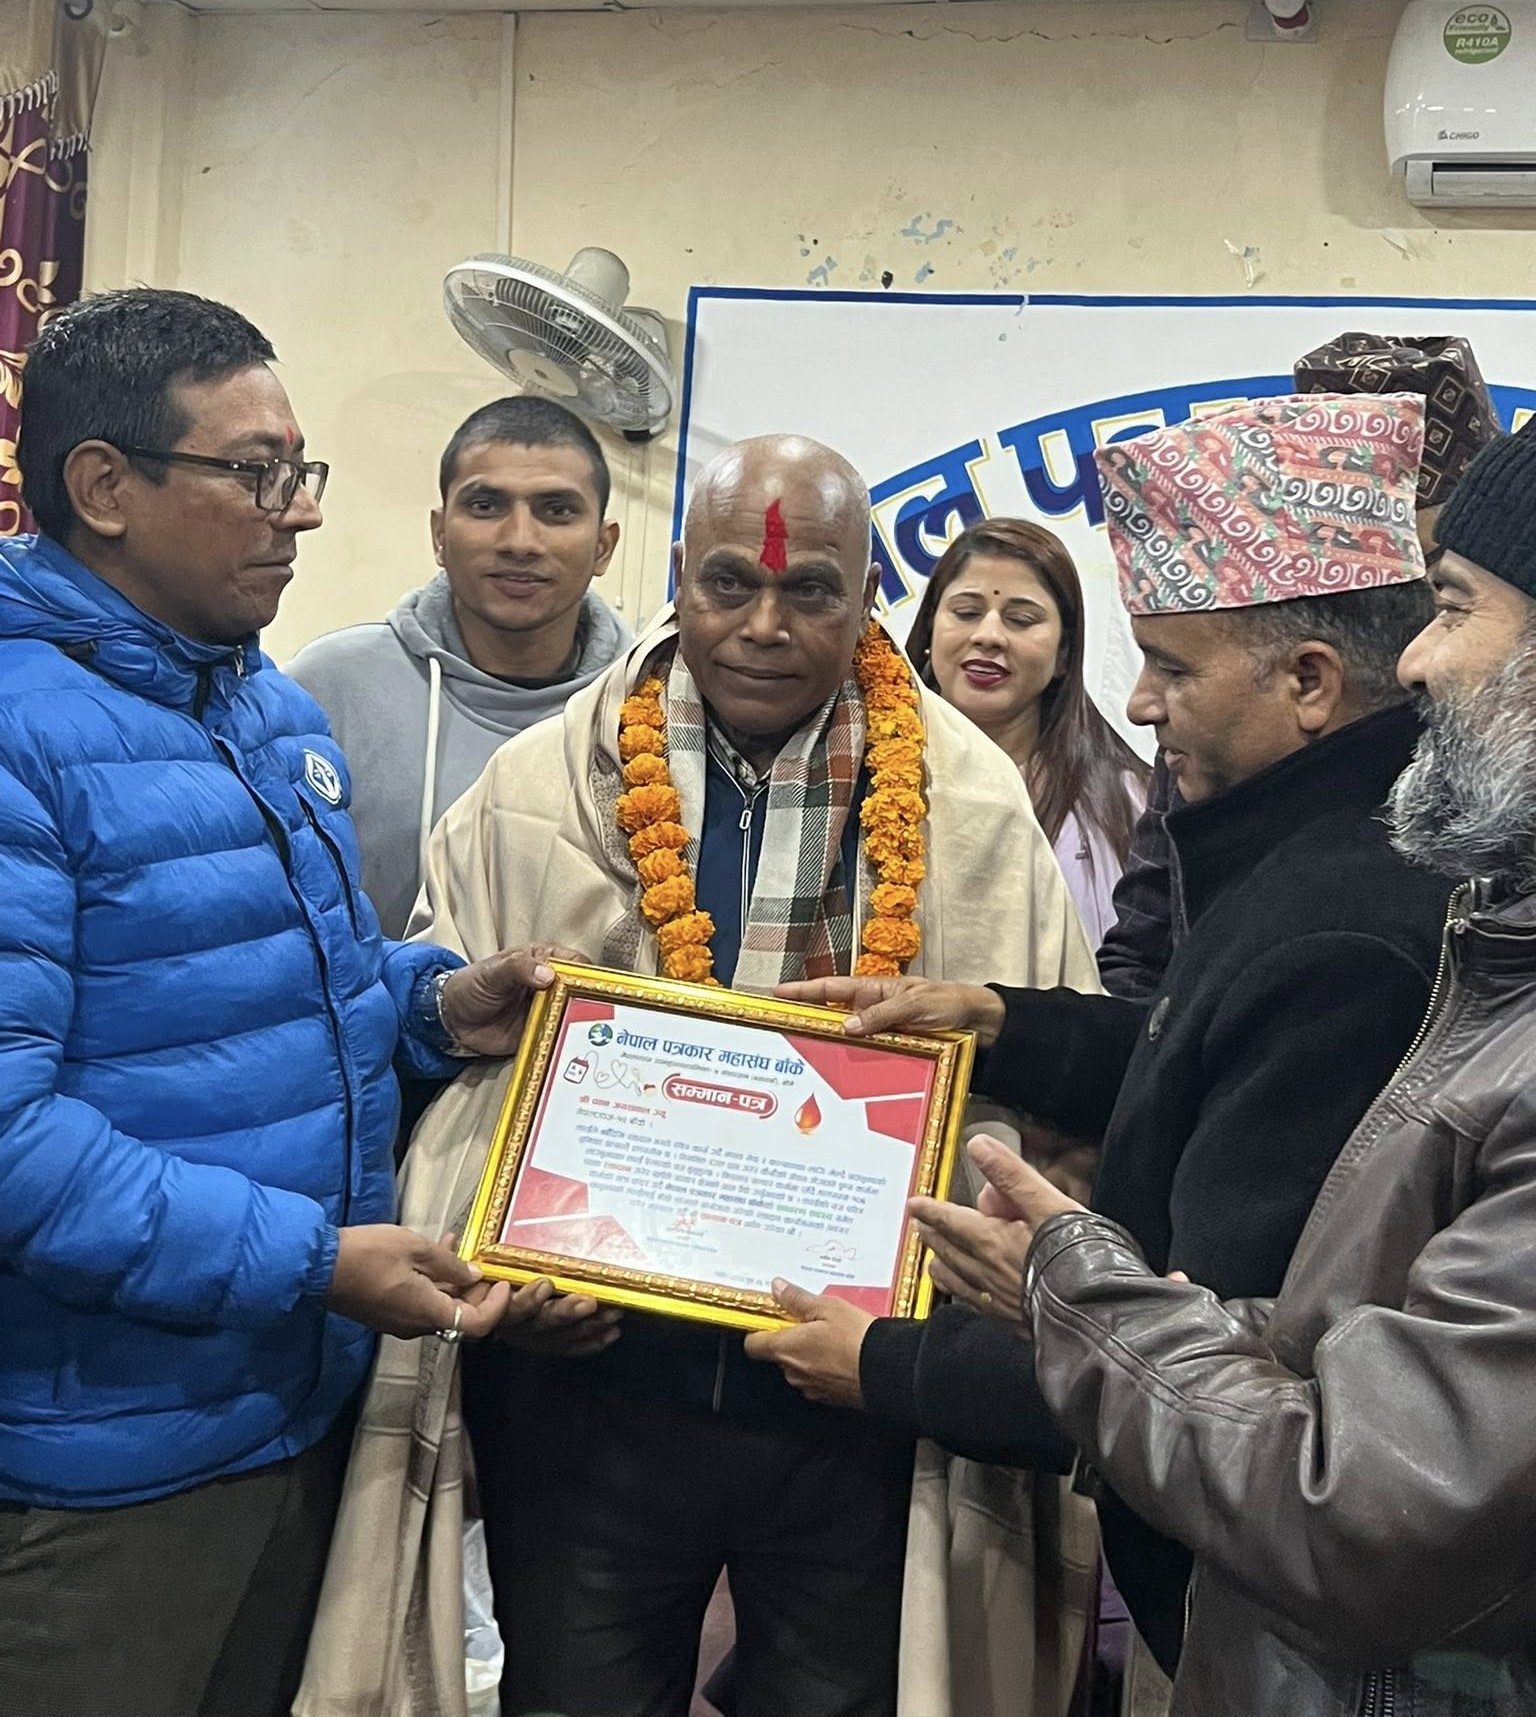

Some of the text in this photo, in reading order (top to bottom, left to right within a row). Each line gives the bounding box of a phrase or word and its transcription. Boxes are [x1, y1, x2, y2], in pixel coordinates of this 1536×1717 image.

[1455, 13, 1489, 24] eco
[1456, 37, 1499, 48] R410A
[1449, 131, 1480, 140] CHIGO
[616, 1028, 658, 1052] नेपाल
[662, 1040, 716, 1061] पत्रकार
[718, 1049, 773, 1071] महासंघ
[671, 1079, 769, 1112] सम्मान-पत्र
